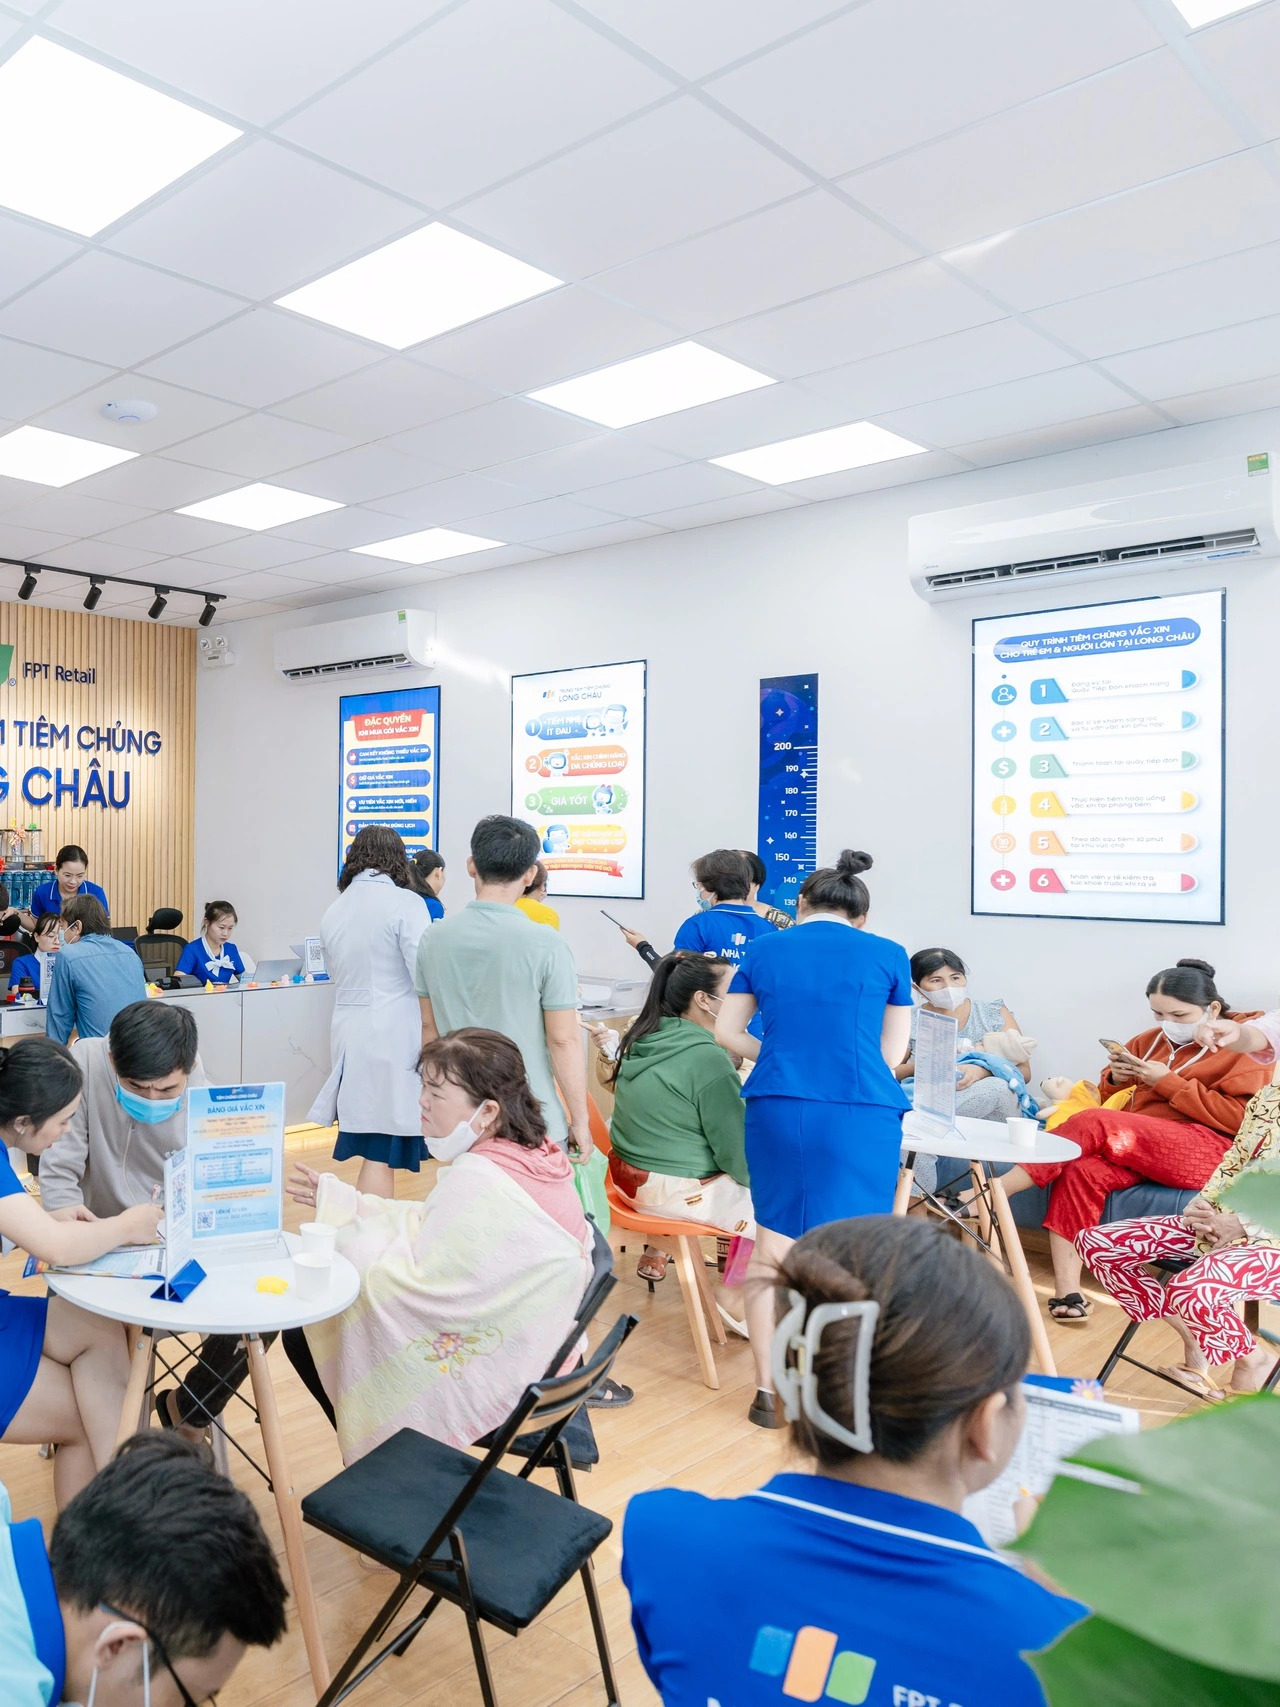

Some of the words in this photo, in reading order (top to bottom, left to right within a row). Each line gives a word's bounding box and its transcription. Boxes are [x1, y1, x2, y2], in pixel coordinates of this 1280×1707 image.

[1021, 638, 1040, 649] QUY
[1041, 635, 1069, 646] TRÌNH
[1070, 632, 1091, 643] TIÊM
[1153, 625, 1171, 635] XIN
[1000, 650, 1020, 659] CHO
[1039, 647, 1053, 656] EM
[1053, 646, 1061, 654] &
[1117, 638, 1133, 649] TẠI
[1135, 635, 1165, 646] LONG
[1166, 631, 1195, 642] CHÂU
[23, 661, 51, 681] FPT
[55, 665, 96, 685] Retail
[1039, 684, 1047, 698] 1
[558, 694, 580, 703] LONG
[530, 722, 536, 734] 1
[546, 726, 554, 736] ÍT
[556, 726, 572, 735] ĐAU
[1039, 723, 1050, 736] 2
[14, 715, 70, 749] TIÊM
[76, 720, 162, 755] CHỦNG
[774, 742, 792, 751] 200
[529, 758, 536, 769] 2
[785, 765, 799, 773] 190
[1039, 760, 1050, 773] 3
[21, 757, 131, 809] CHÂU
[785, 787, 799, 795] 180
[529, 796, 536, 807] 3
[551, 794, 567, 806] GIÁ
[1038, 797, 1051, 811] 4
[785, 809, 798, 818] 170
[784, 832, 798, 840] 160
[1038, 836, 1049, 850] 5
[774, 853, 790, 862] 150
[783, 876, 797, 884] 140
[1037, 874, 1050, 887] 6
[721, 948, 740, 959] NHÀ
[227, 1104, 238, 1113] GIÁ
[255, 1103, 266, 1111] XIN
